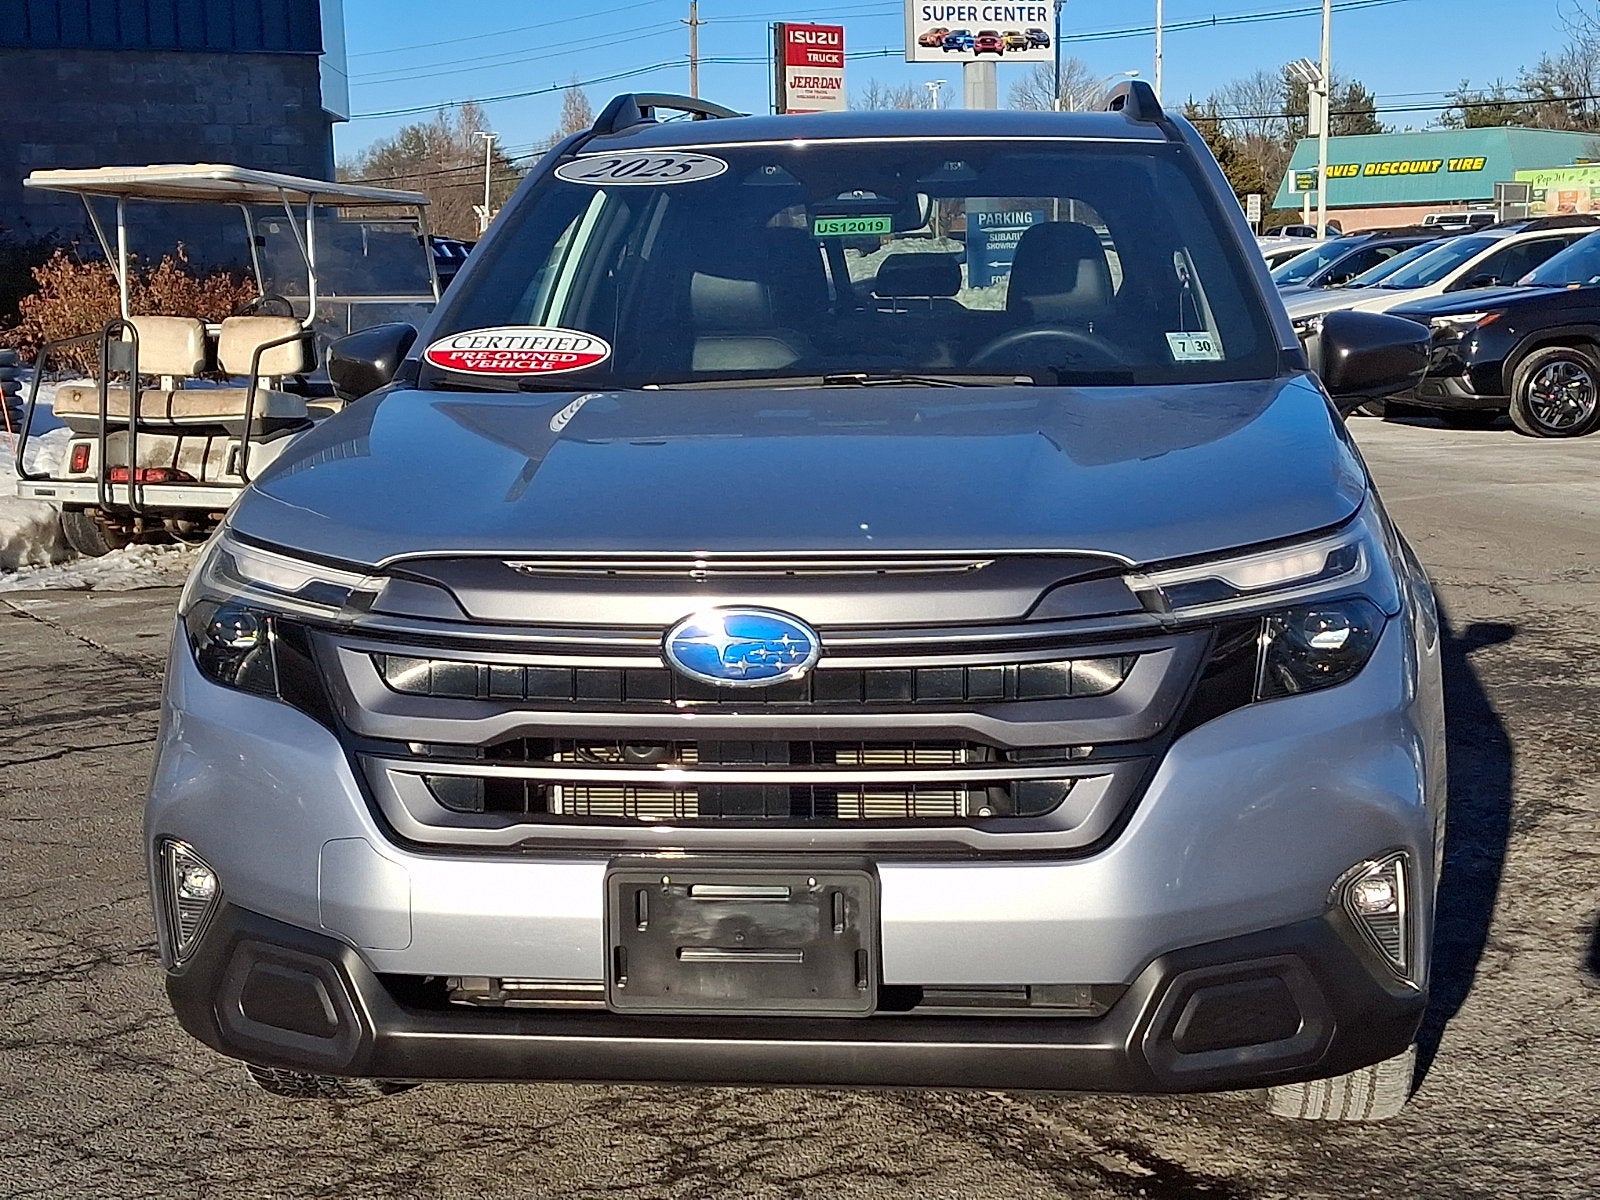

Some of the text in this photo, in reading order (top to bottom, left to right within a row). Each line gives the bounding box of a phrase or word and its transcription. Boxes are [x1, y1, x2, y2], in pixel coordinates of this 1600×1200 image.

[922, 5, 1047, 21] SUPER CENTER
[789, 30, 839, 45] ISUZU
[806, 52, 839, 63] TRUCK
[584, 158, 704, 179] 2025
[1326, 158, 1486, 177] AVIS DISCOUNT TIRE
[978, 211, 1033, 225] PARKING
[816, 220, 884, 235] US12019
[451, 335, 592, 351] CERTIFIED
[1178, 340, 1211, 353] 7 30
[448, 351, 578, 362] PRE-OWNED
[464, 360, 556, 370] VEHICLE
